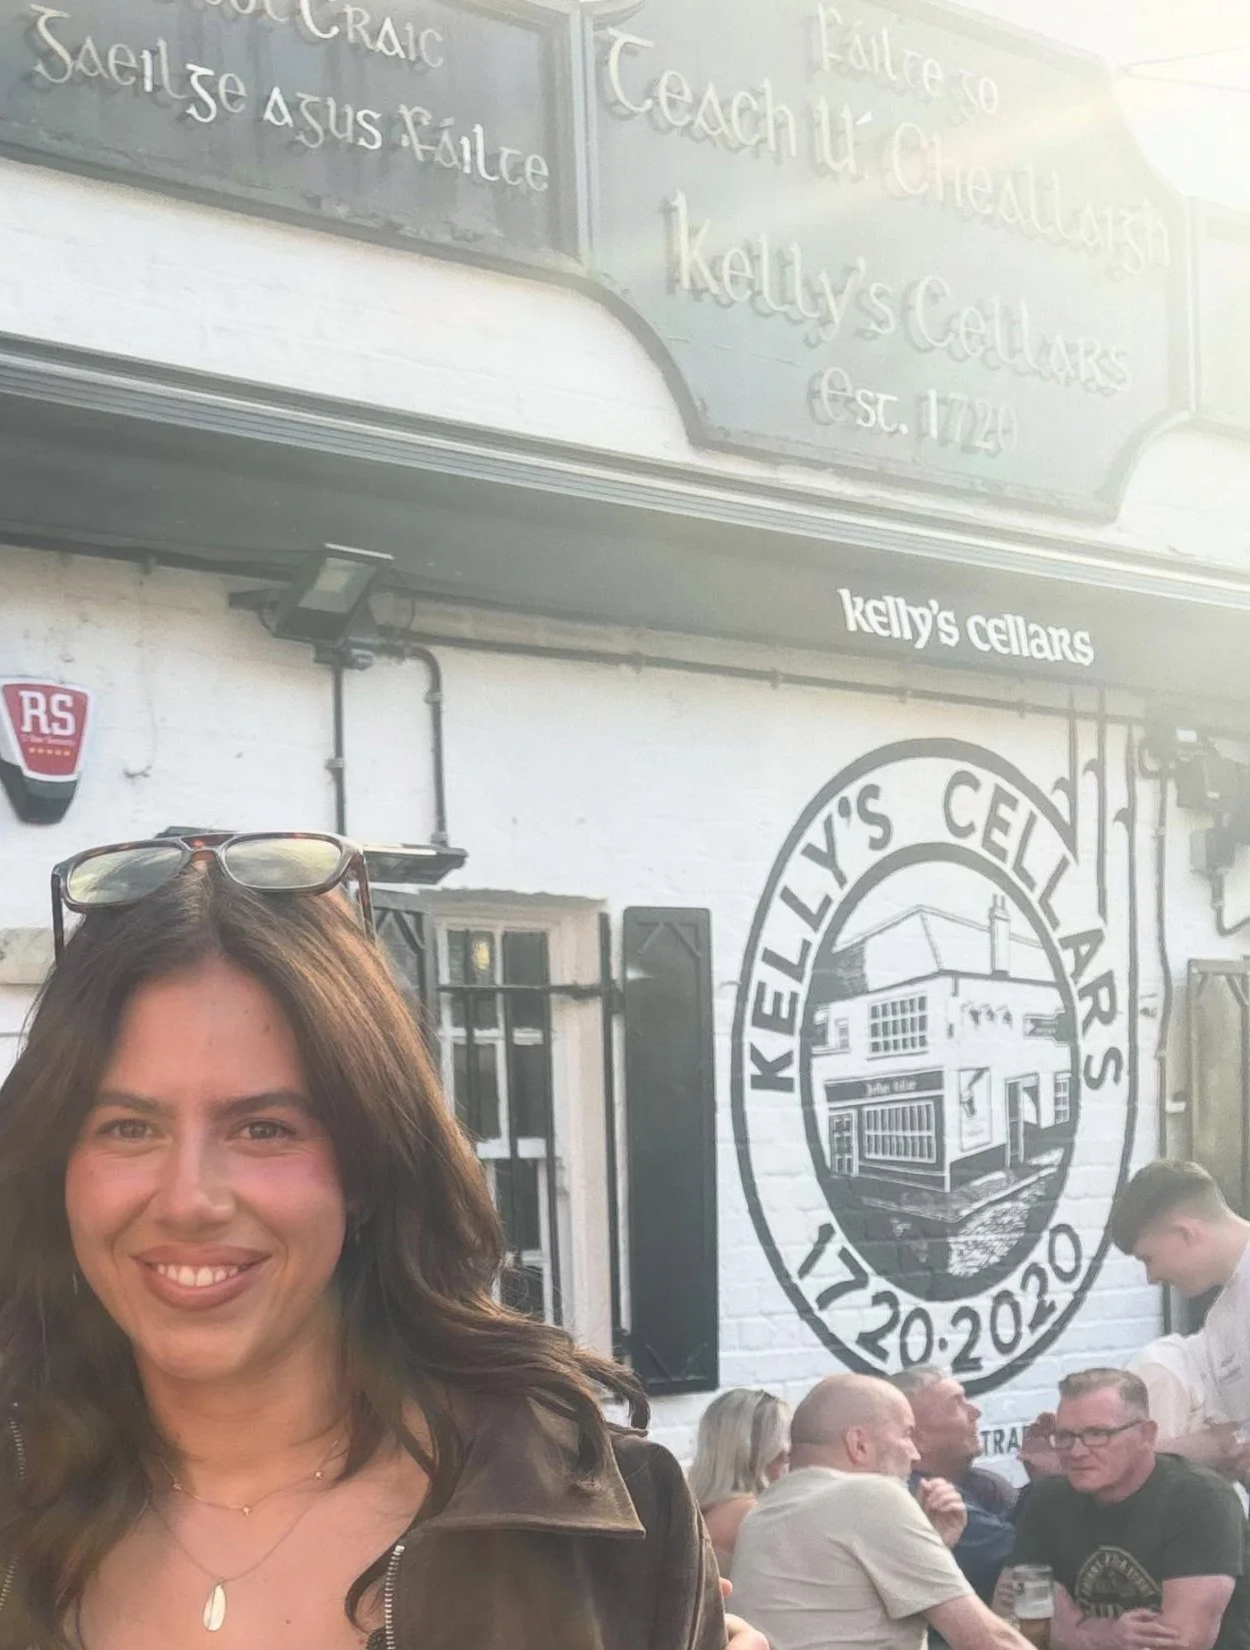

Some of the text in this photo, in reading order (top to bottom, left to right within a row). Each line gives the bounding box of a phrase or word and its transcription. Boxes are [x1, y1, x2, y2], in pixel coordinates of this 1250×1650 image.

[926, 388, 1017, 453] 1720
[18, 689, 77, 736] RS
[750, 769, 1124, 1093] KELLY'S CELLARS
[979, 1425, 1032, 1457] TRA
